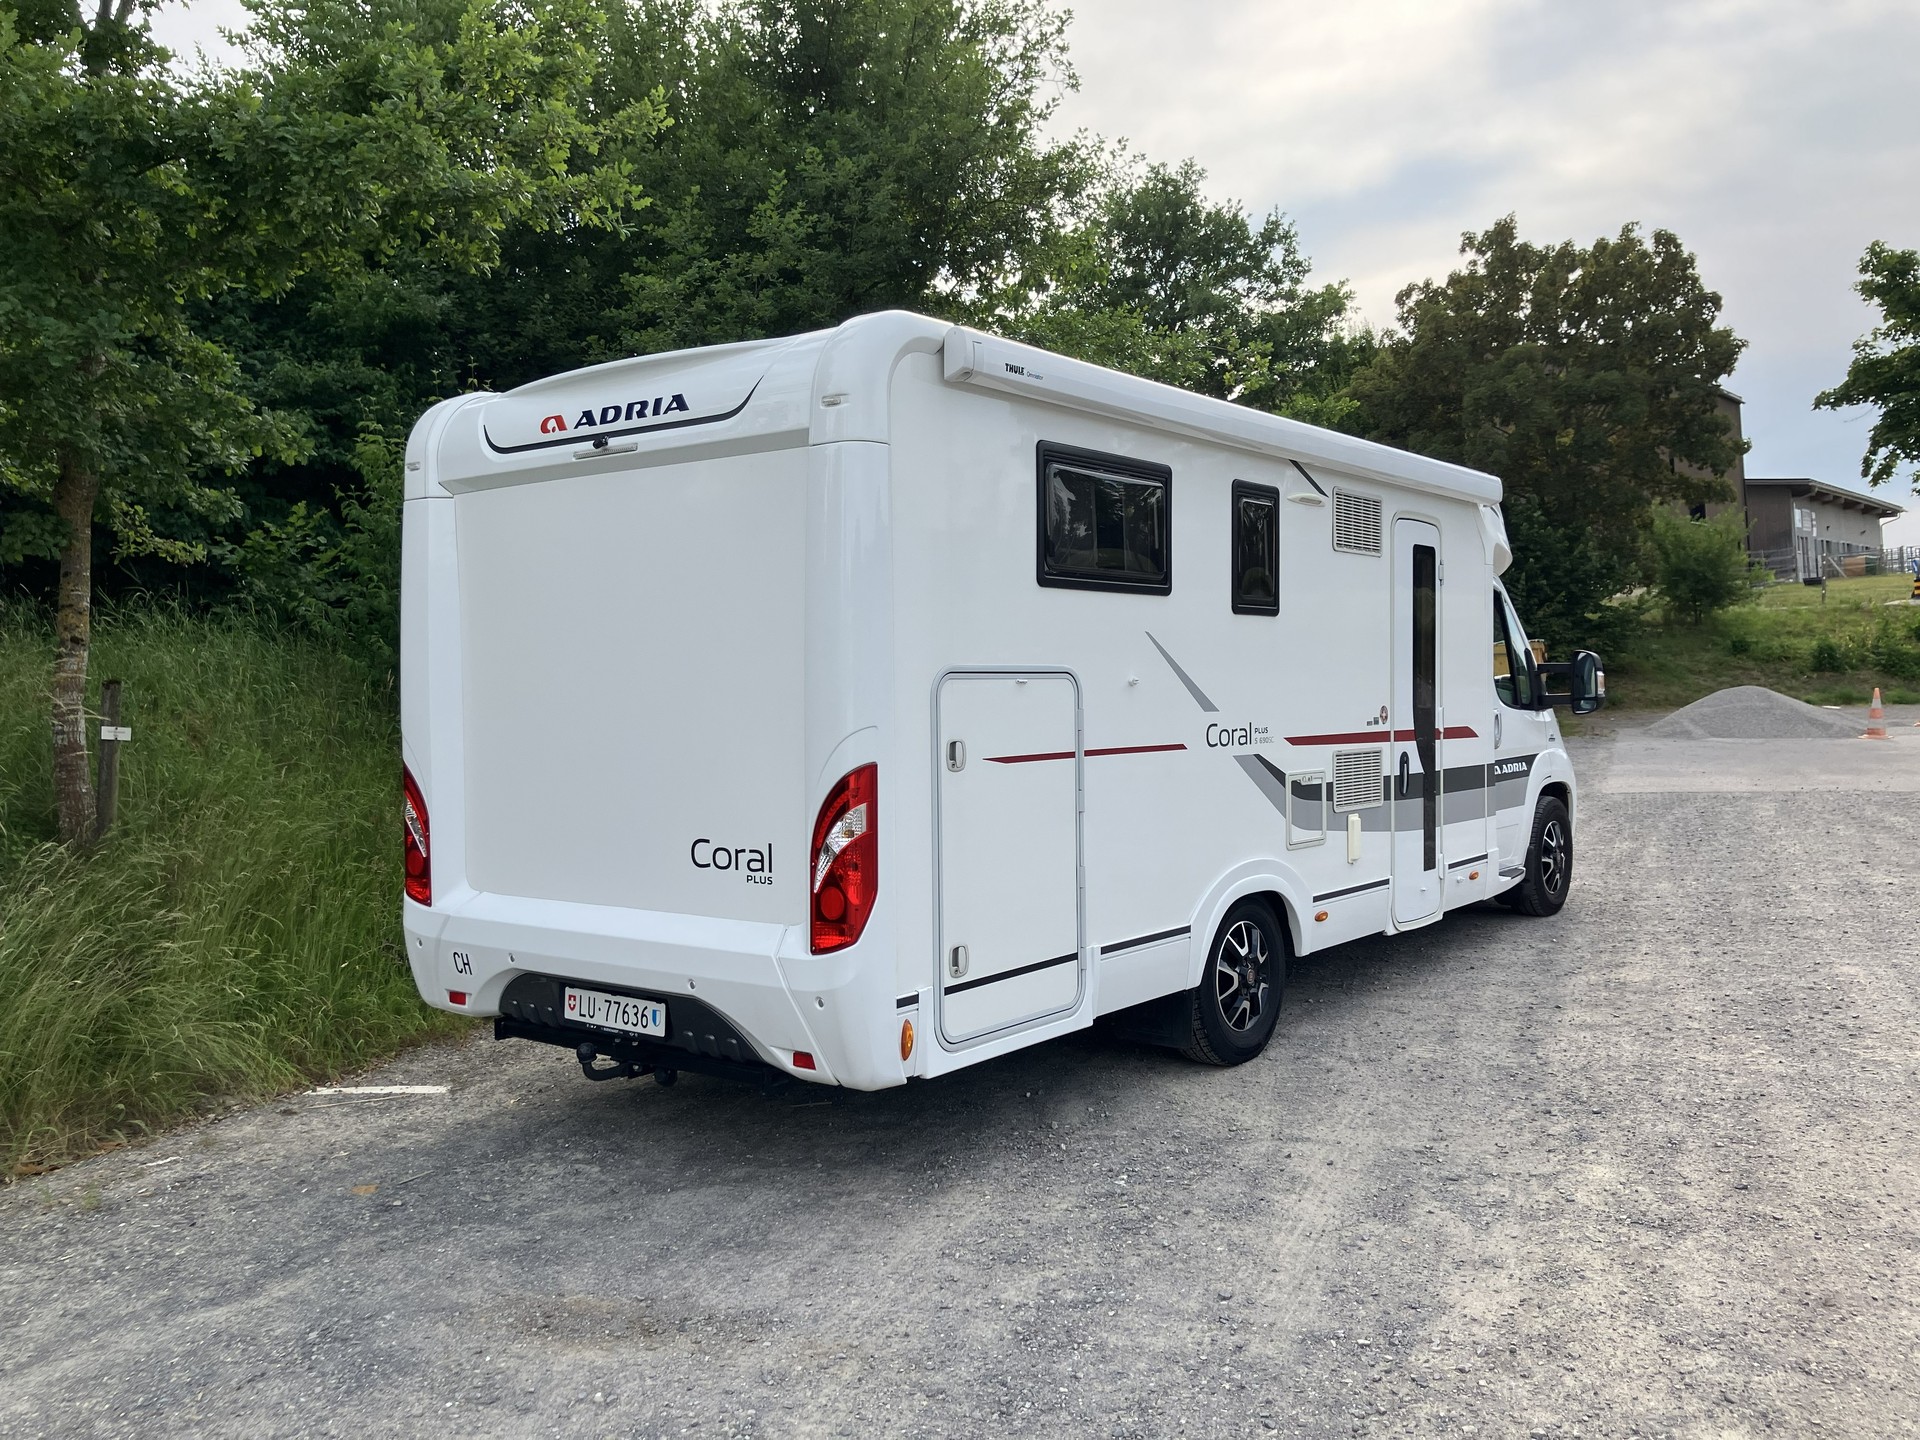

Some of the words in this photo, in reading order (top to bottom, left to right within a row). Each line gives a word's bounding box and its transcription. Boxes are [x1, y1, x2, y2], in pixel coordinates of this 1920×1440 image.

[1005, 363, 1025, 376] THULE
[574, 393, 690, 430] ADRIA
[1206, 721, 1252, 748] Coral
[1502, 761, 1528, 774] ADRIA
[690, 838, 773, 873] Coral
[746, 875, 773, 885] PLUS
[453, 951, 473, 975] CH
